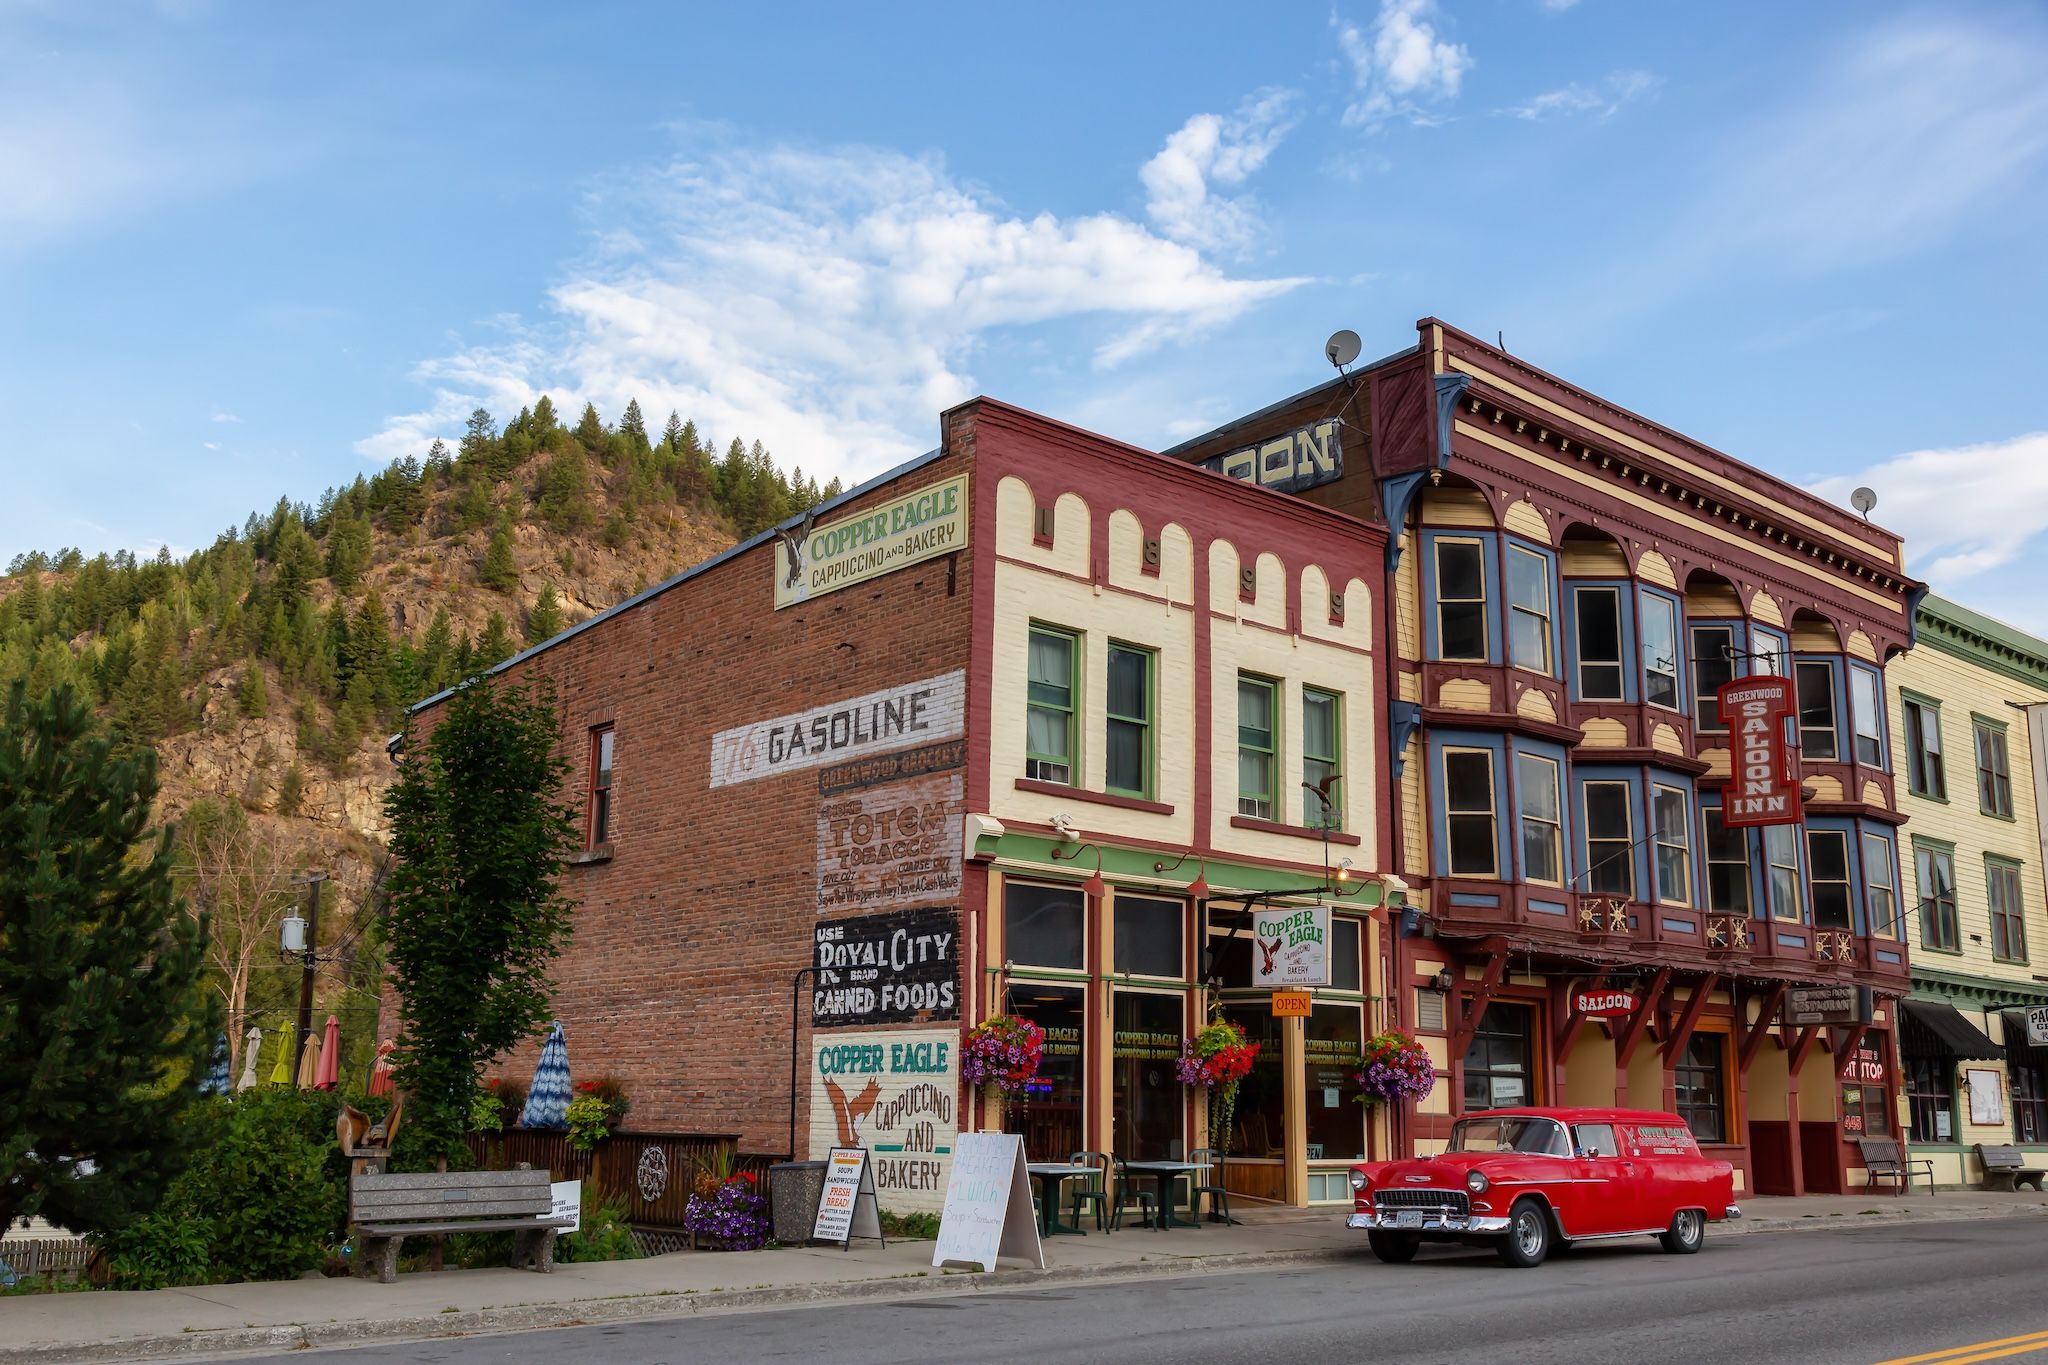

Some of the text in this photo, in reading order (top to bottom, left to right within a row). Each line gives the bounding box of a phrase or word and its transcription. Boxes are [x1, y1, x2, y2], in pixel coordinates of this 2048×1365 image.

[1200, 423, 1335, 484] OON
[811, 486, 959, 561] COPPER EAGLE
[812, 522, 955, 588] CAPPUCCINO AND BAKERY
[1727, 687, 1783, 705] GREENWOOD
[723, 689, 931, 777] 76 GASOLINE
[1742, 701, 1772, 795] SALOON
[1734, 795, 1785, 814] INN
[830, 802, 947, 847] TOTEM
[838, 835, 936, 869] TOBACCO
[817, 926, 844, 942] USE
[1259, 910, 1323, 948] COPPER EAGLE
[819, 928, 952, 984] ROYAL CITY
[850, 969, 879, 982] BRAND
[1287, 966, 1309, 975] BAKERY
[814, 980, 954, 1016] CANNED FOODS
[1276, 998, 1307, 1010] OPEN
[1578, 994, 1633, 1012] SALOON
[1049, 1028, 1079, 1042] EAGLE
[1115, 1032, 1179, 1047] COPPER EAGLE
[1305, 1039, 1358, 1052] COPPER EAGLE
[818, 1042, 949, 1074] COPPER EAGLE
[1053, 1044, 1080, 1055] BAKERY
[875, 1082, 951, 1131] CAPPUCCINO
[904, 1121, 934, 1153] AND
[827, 1176, 859, 1184] SANDWICHES
[837, 1166, 854, 1174] SOUPS
[878, 1159, 941, 1190] BAKERY
[830, 1187, 851, 1197] FRESH
